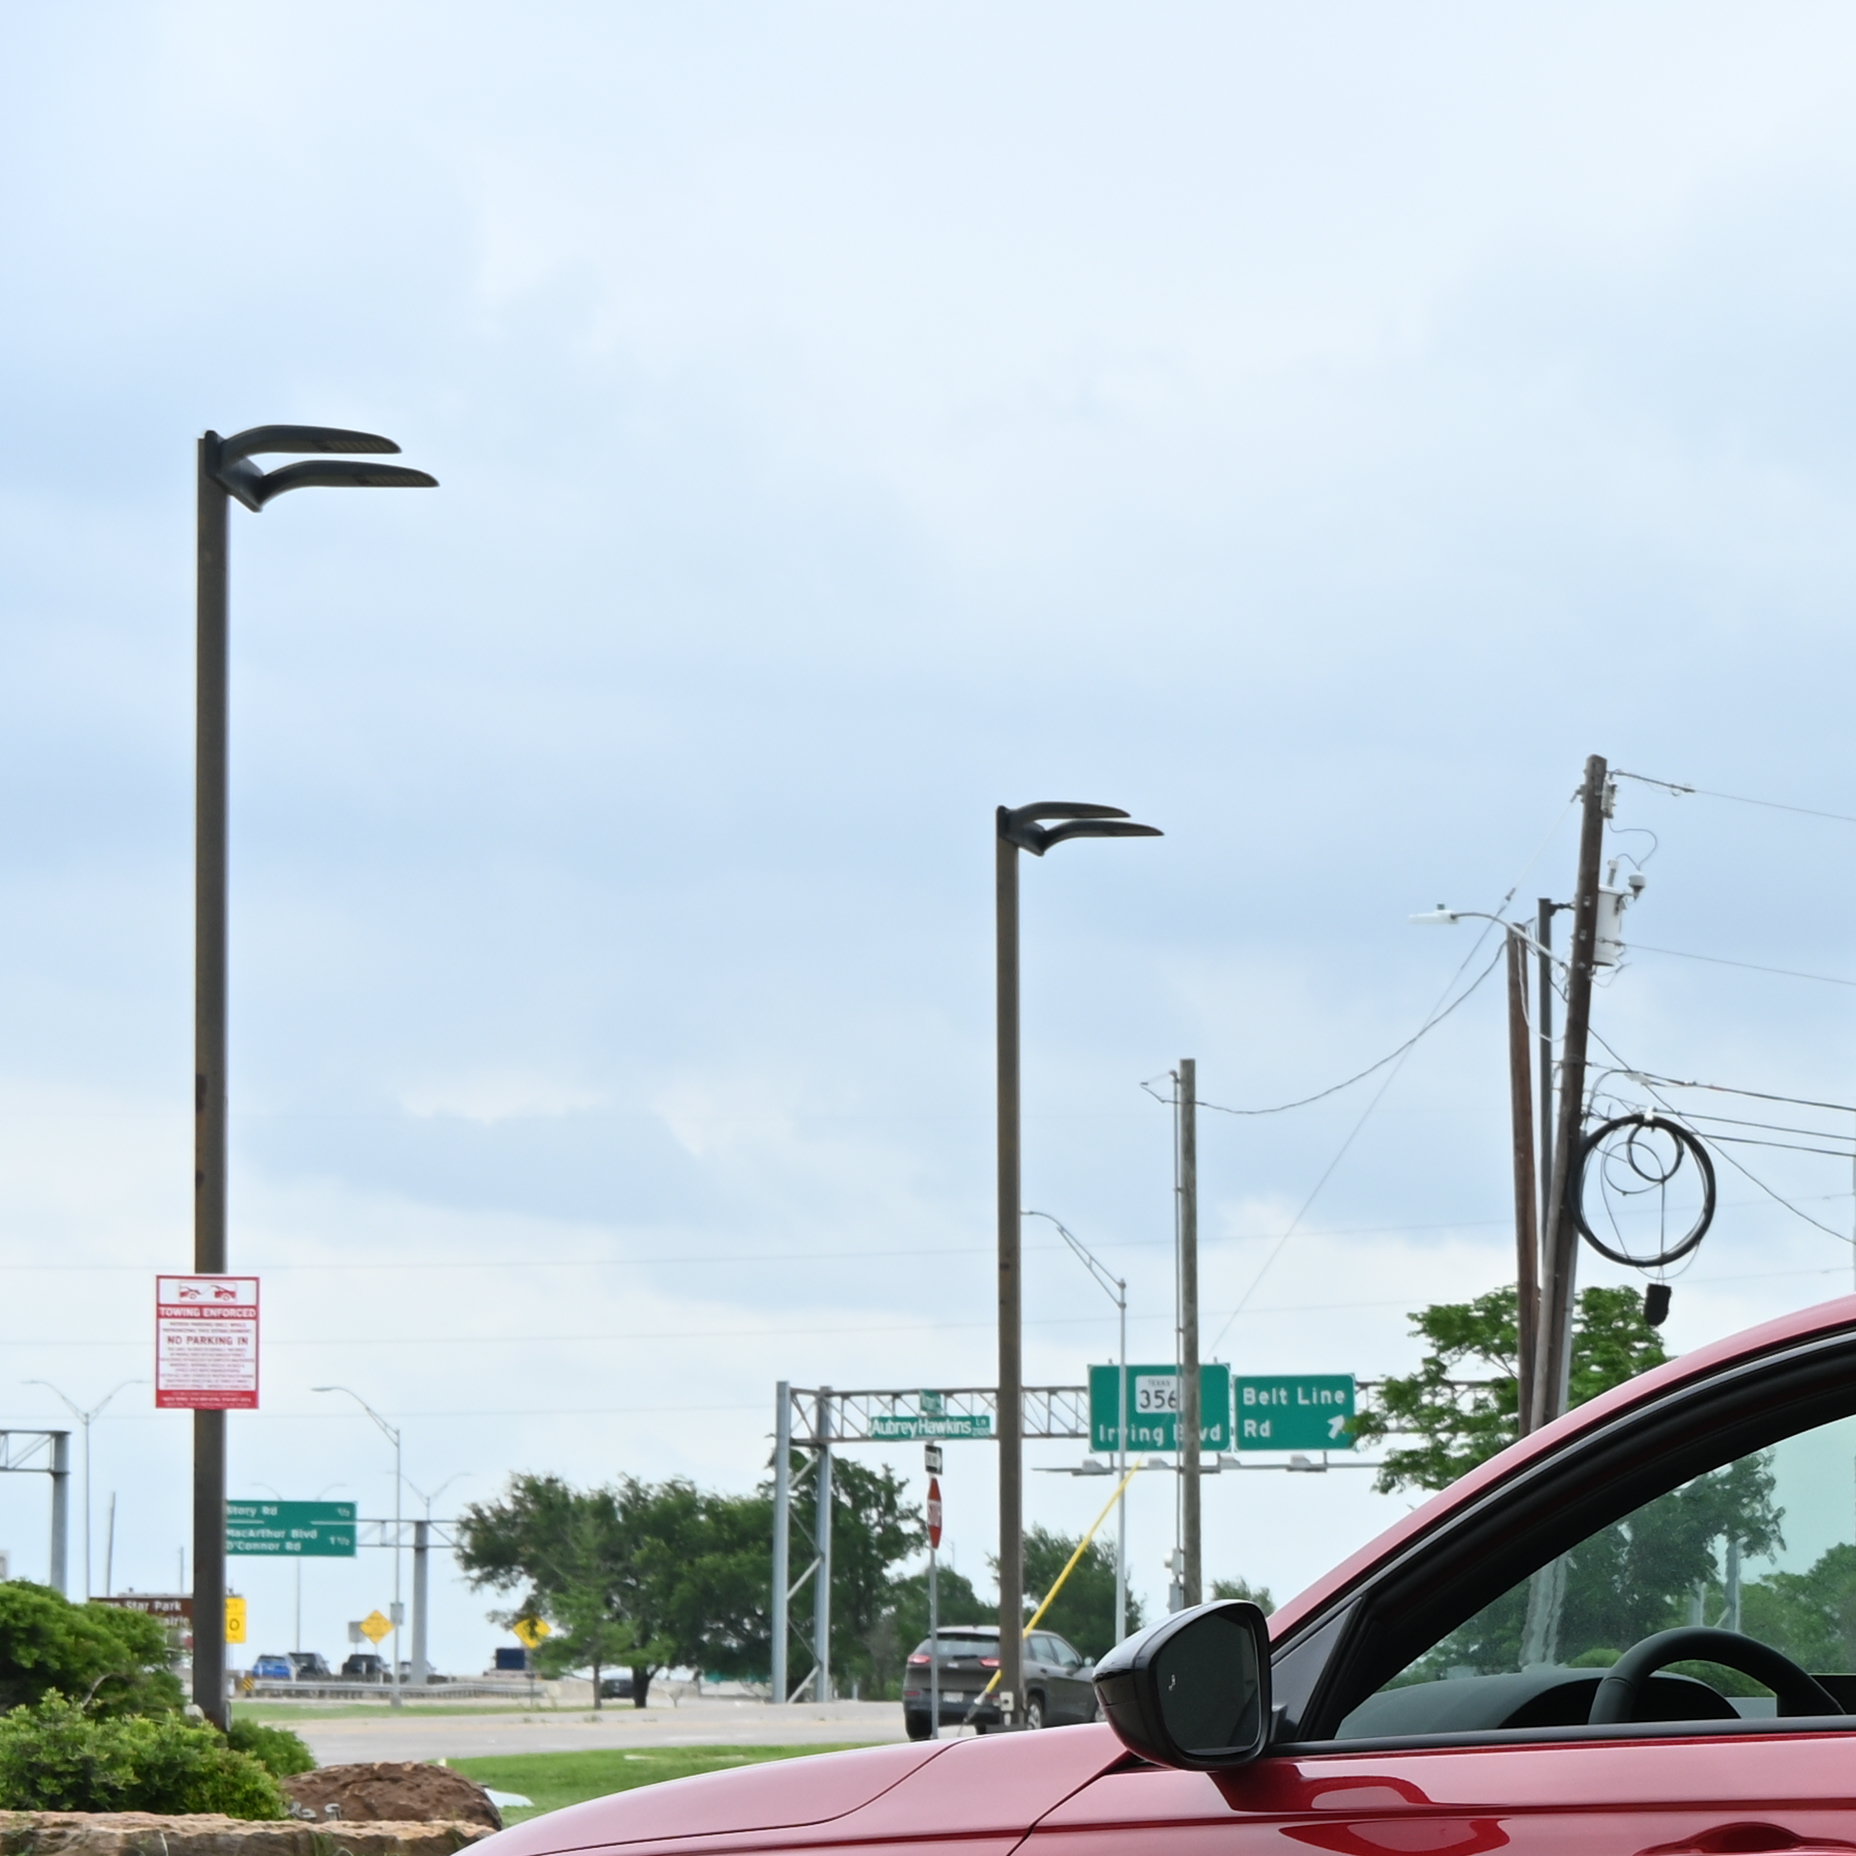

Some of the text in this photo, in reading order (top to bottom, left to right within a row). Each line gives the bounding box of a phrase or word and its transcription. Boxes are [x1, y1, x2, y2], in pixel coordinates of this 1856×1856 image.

[159, 1306, 257, 1319] TOWING ENFORCED
[166, 1335, 249, 1346] NO PARKING IN
[1138, 1388, 1177, 1410] 356
[1242, 1386, 1346, 1406] Belt Line
[871, 1418, 972, 1438] Aubrey Hawkins
[1243, 1418, 1271, 1438] Rd
[1098, 1423, 1222, 1448] Iring Bvd
[225, 1505, 278, 1518] Story Rd
[225, 1528, 318, 1539] MacArthur Blvd
[225, 1541, 302, 1552] O'Connor Rd
[126, 1600, 149, 1611] Star
[154, 1600, 182, 1611] Park
